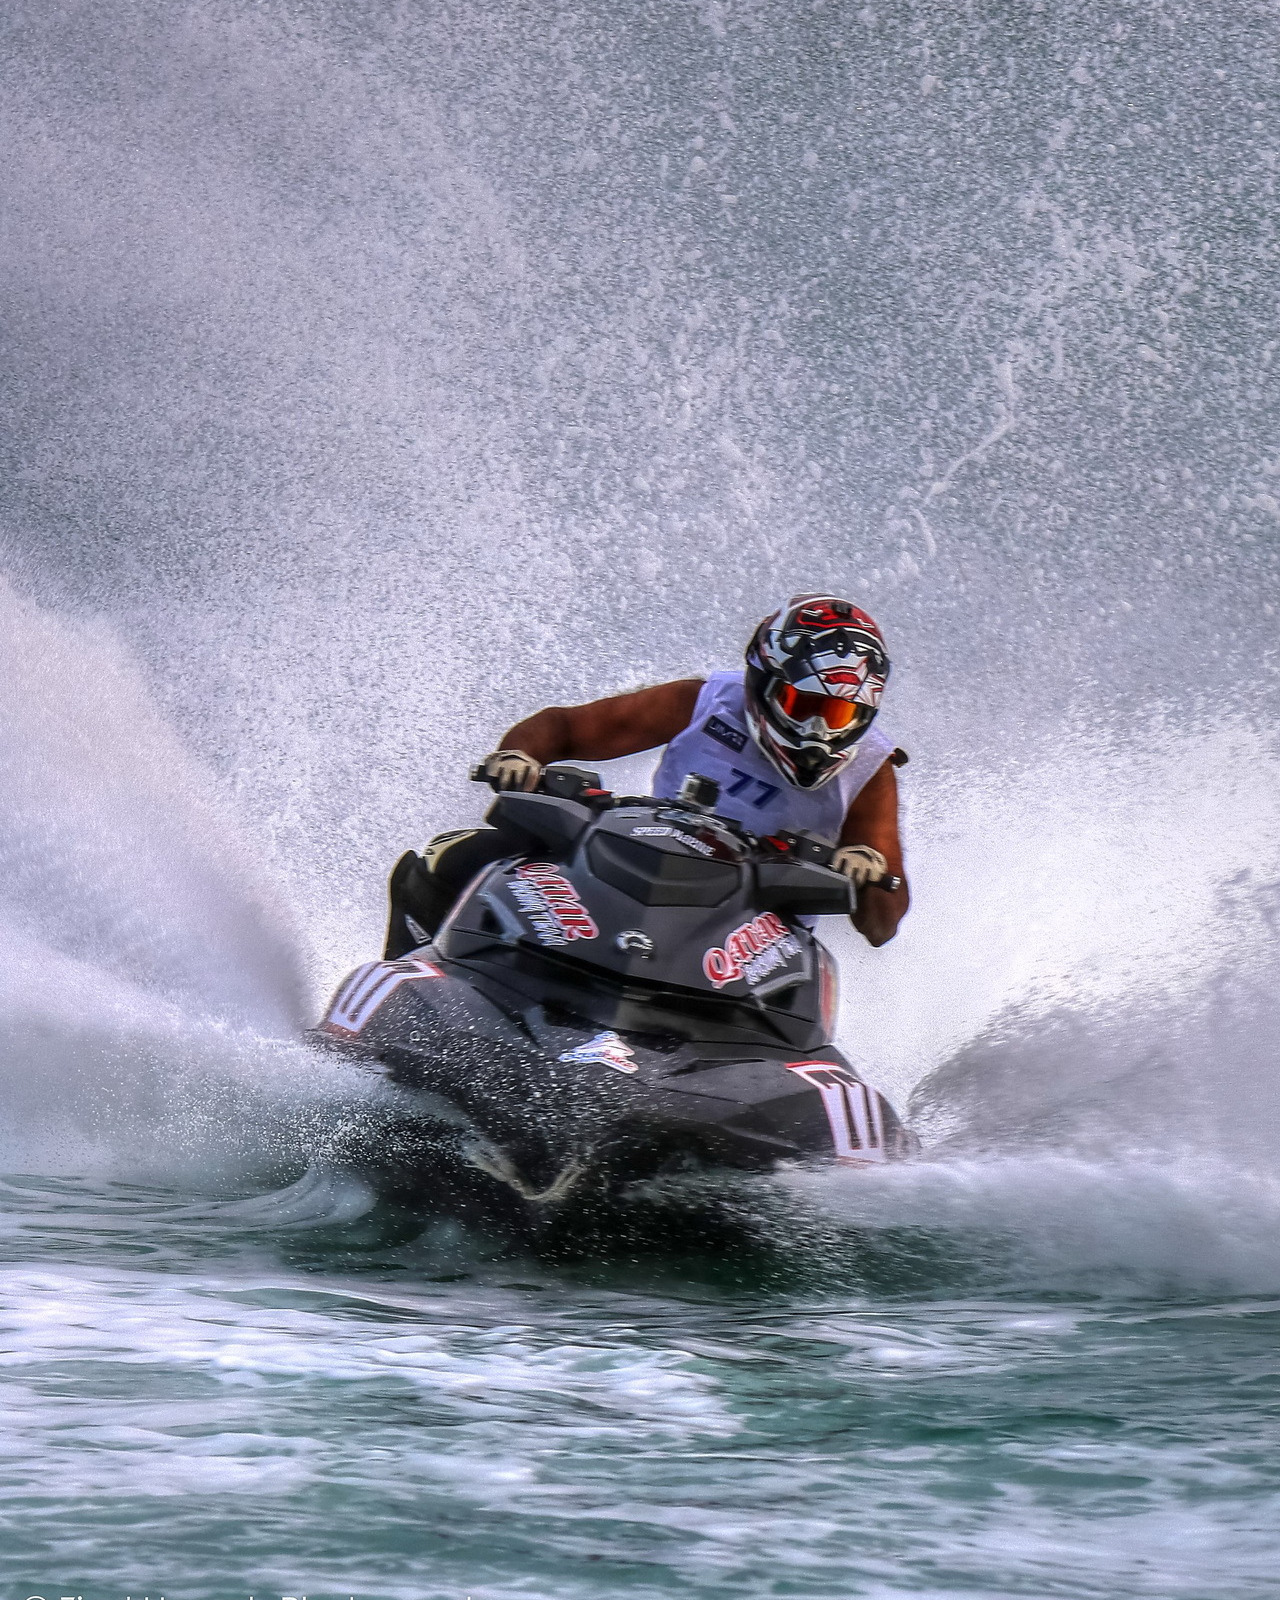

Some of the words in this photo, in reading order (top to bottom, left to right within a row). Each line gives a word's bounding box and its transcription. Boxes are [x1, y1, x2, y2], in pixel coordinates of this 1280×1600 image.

[726, 767, 782, 810] 77
[514, 862, 600, 941] QATAR
[702, 911, 791, 990] QATAR
